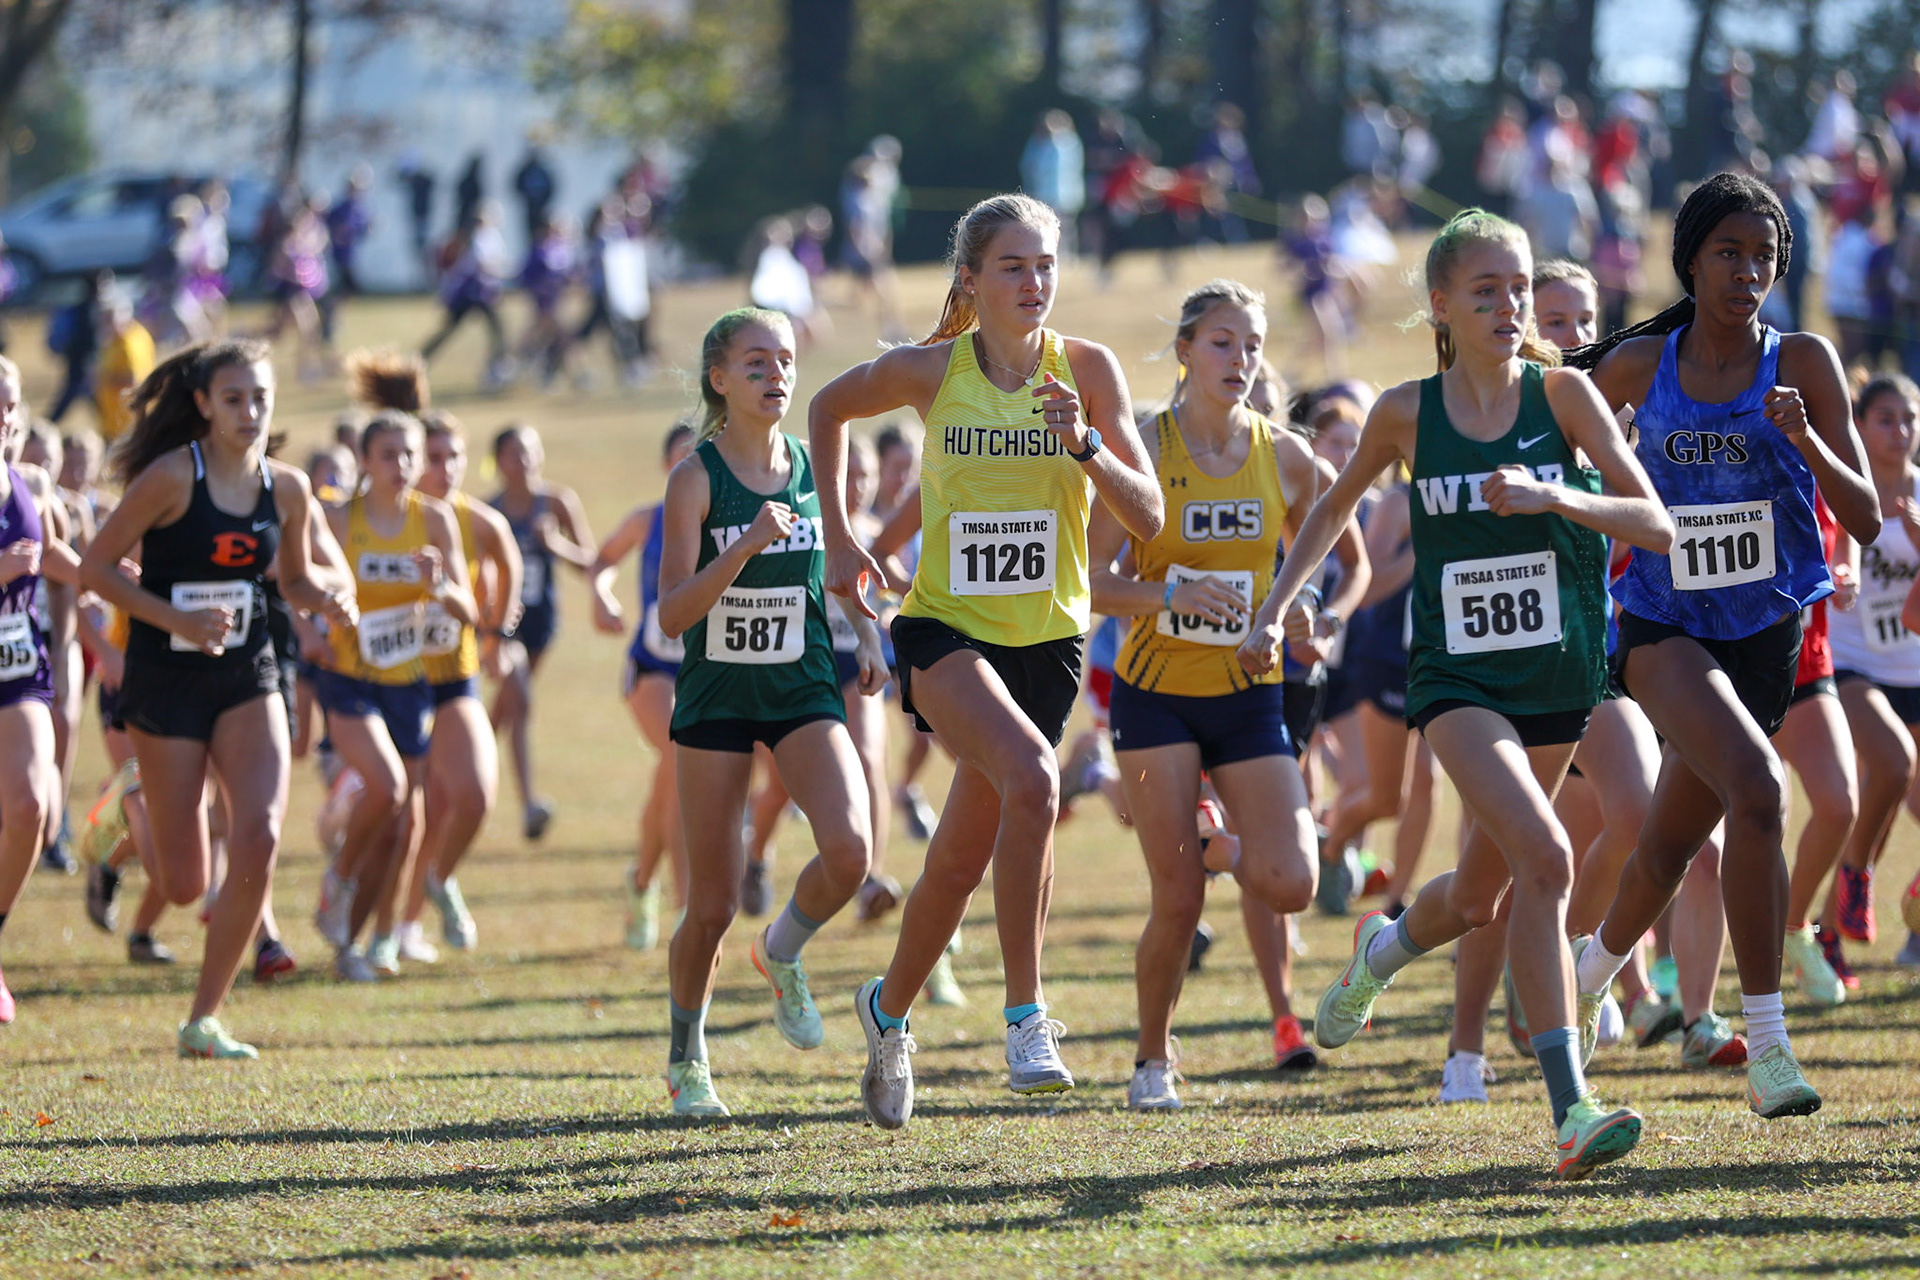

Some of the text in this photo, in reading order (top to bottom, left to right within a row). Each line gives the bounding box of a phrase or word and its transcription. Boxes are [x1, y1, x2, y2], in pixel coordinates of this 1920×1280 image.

[1664, 430, 1748, 465] GPS
[962, 520, 1048, 534] TMSAA STATE XC
[1182, 499, 1263, 543] CCS
[1677, 509, 1763, 528] TMSAA STATE XC
[211, 531, 258, 567] E
[961, 541, 1045, 582] 1126
[1680, 531, 1760, 577] 1110
[1453, 563, 1546, 586] TMSAA STATE XC
[721, 595, 797, 609] TMSAA STATE XC
[1461, 588, 1543, 639] 588
[724, 616, 788, 653] 587
